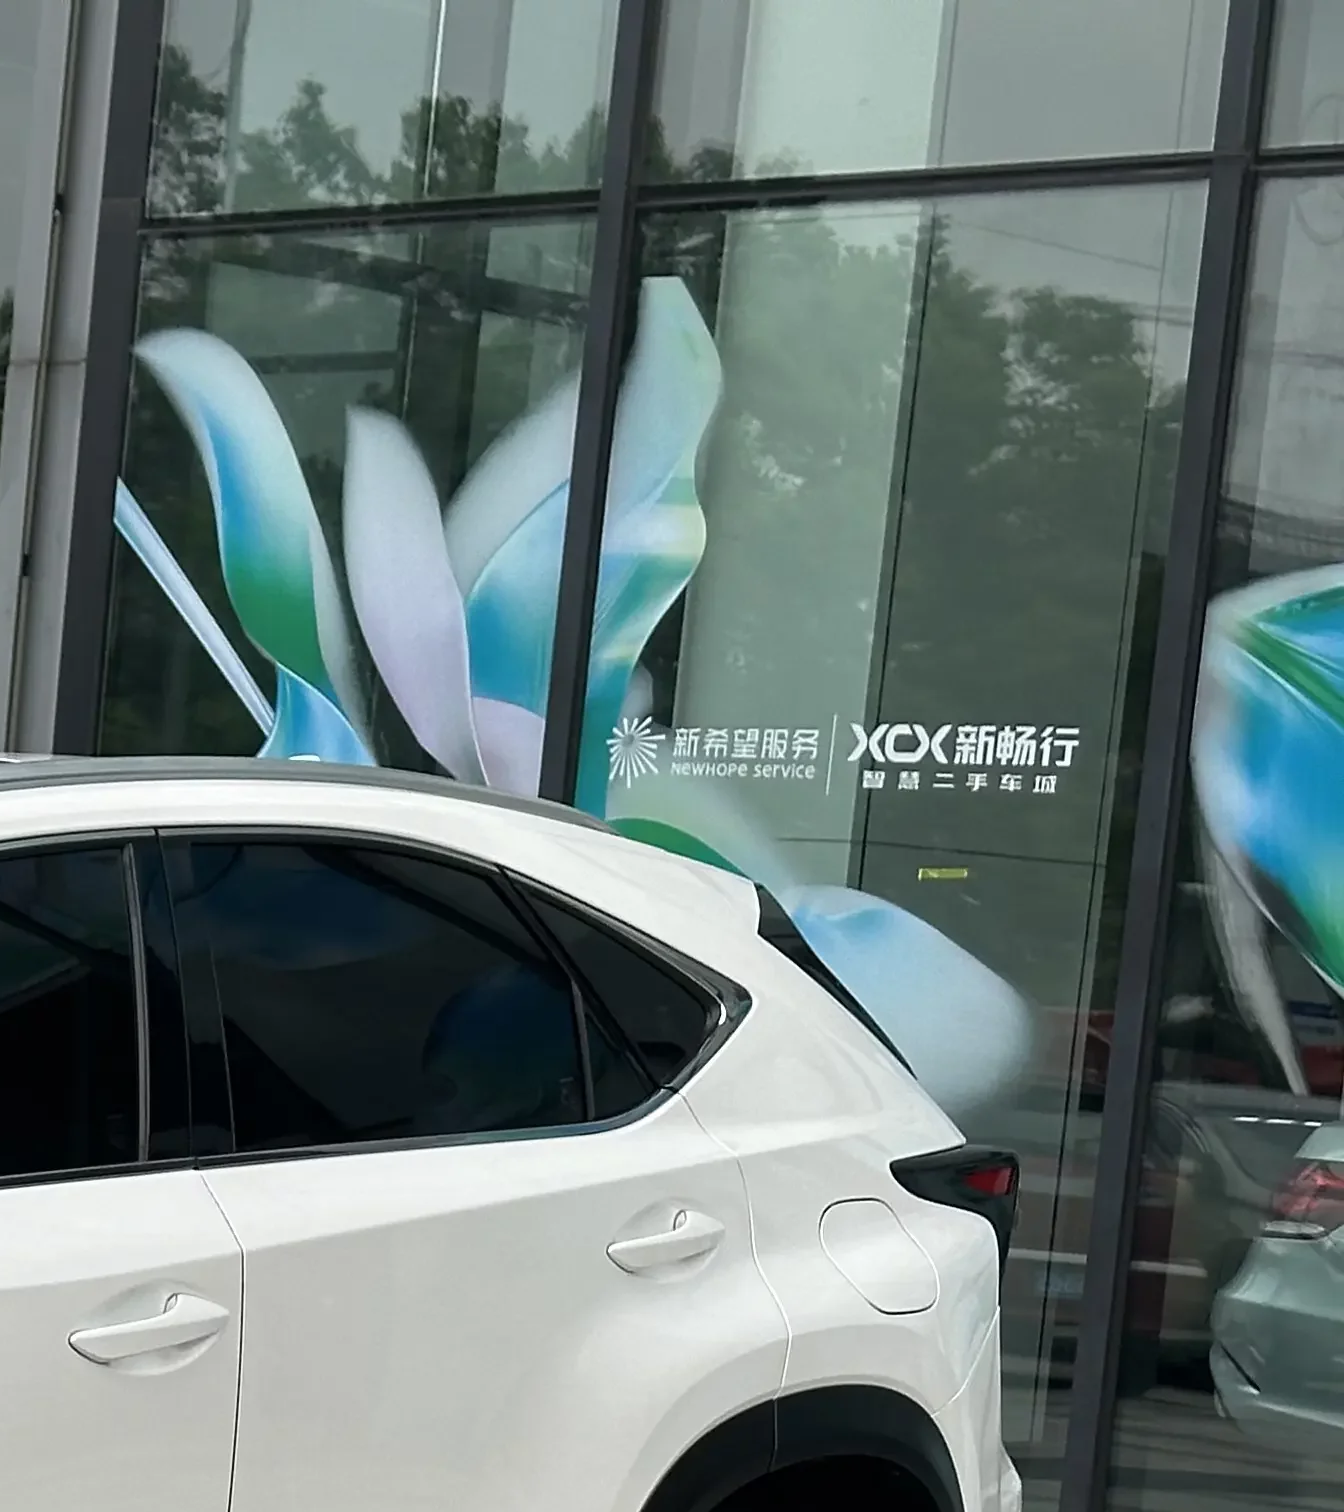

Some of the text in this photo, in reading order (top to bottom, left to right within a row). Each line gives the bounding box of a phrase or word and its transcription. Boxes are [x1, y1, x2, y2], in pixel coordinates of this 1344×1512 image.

[672, 728, 820, 760] 新希望服务
[954, 725, 1081, 767] 新畅行
[862, 770, 1058, 793] 智慧二手车城
